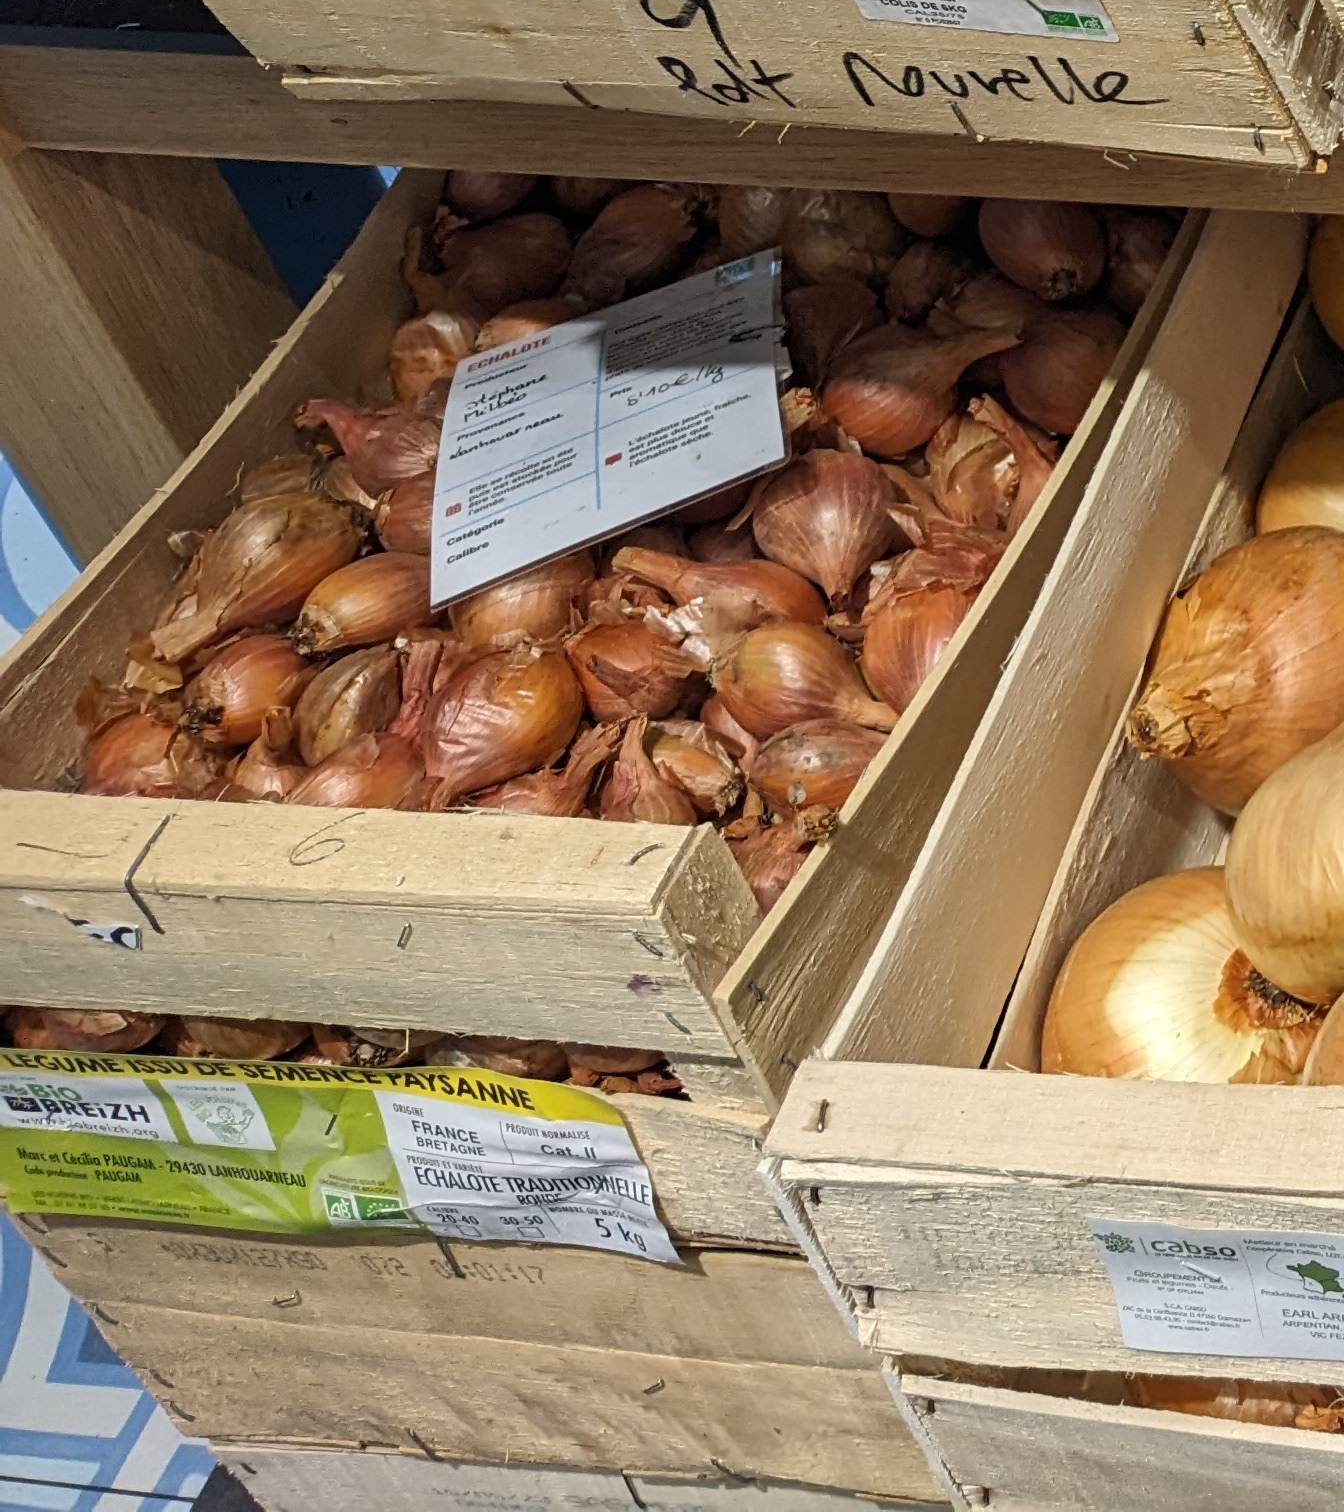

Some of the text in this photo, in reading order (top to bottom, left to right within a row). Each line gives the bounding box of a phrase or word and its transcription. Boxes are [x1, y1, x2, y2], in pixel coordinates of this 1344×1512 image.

[921, 3, 939, 11] DE
[467, 335, 551, 374] ECHALOTE
[446, 517, 505, 547] Catégorie
[446, 541, 490, 565] Calibre
[3, 1053, 536, 1111] LEGUME ISSU DE SEMENCE PAYSANNE
[393, 1103, 425, 1118] ORIGINE
[411, 1120, 481, 1145] FRANCE
[506, 1122, 540, 1138] PRODUIT
[416, 1136, 487, 1157] BRETAGNE
[540, 1144, 580, 1158] Cat.
[103, 1154, 156, 1172] PAUGAM
[165, 1159, 205, 1176] 29430
[207, 1163, 306, 1188] LANHOUARNEAU
[414, 1166, 501, 1193] ECHALOTE
[438, 1214, 480, 1226] 20-40
[500, 1215, 544, 1226] 30-50
[595, 1219, 648, 1253] 5 kg
[1151, 1240, 1237, 1257] cabso
[1134, 1269, 1206, 1282] GROUPEMENT
[1282, 1308, 1320, 1320] EARL
